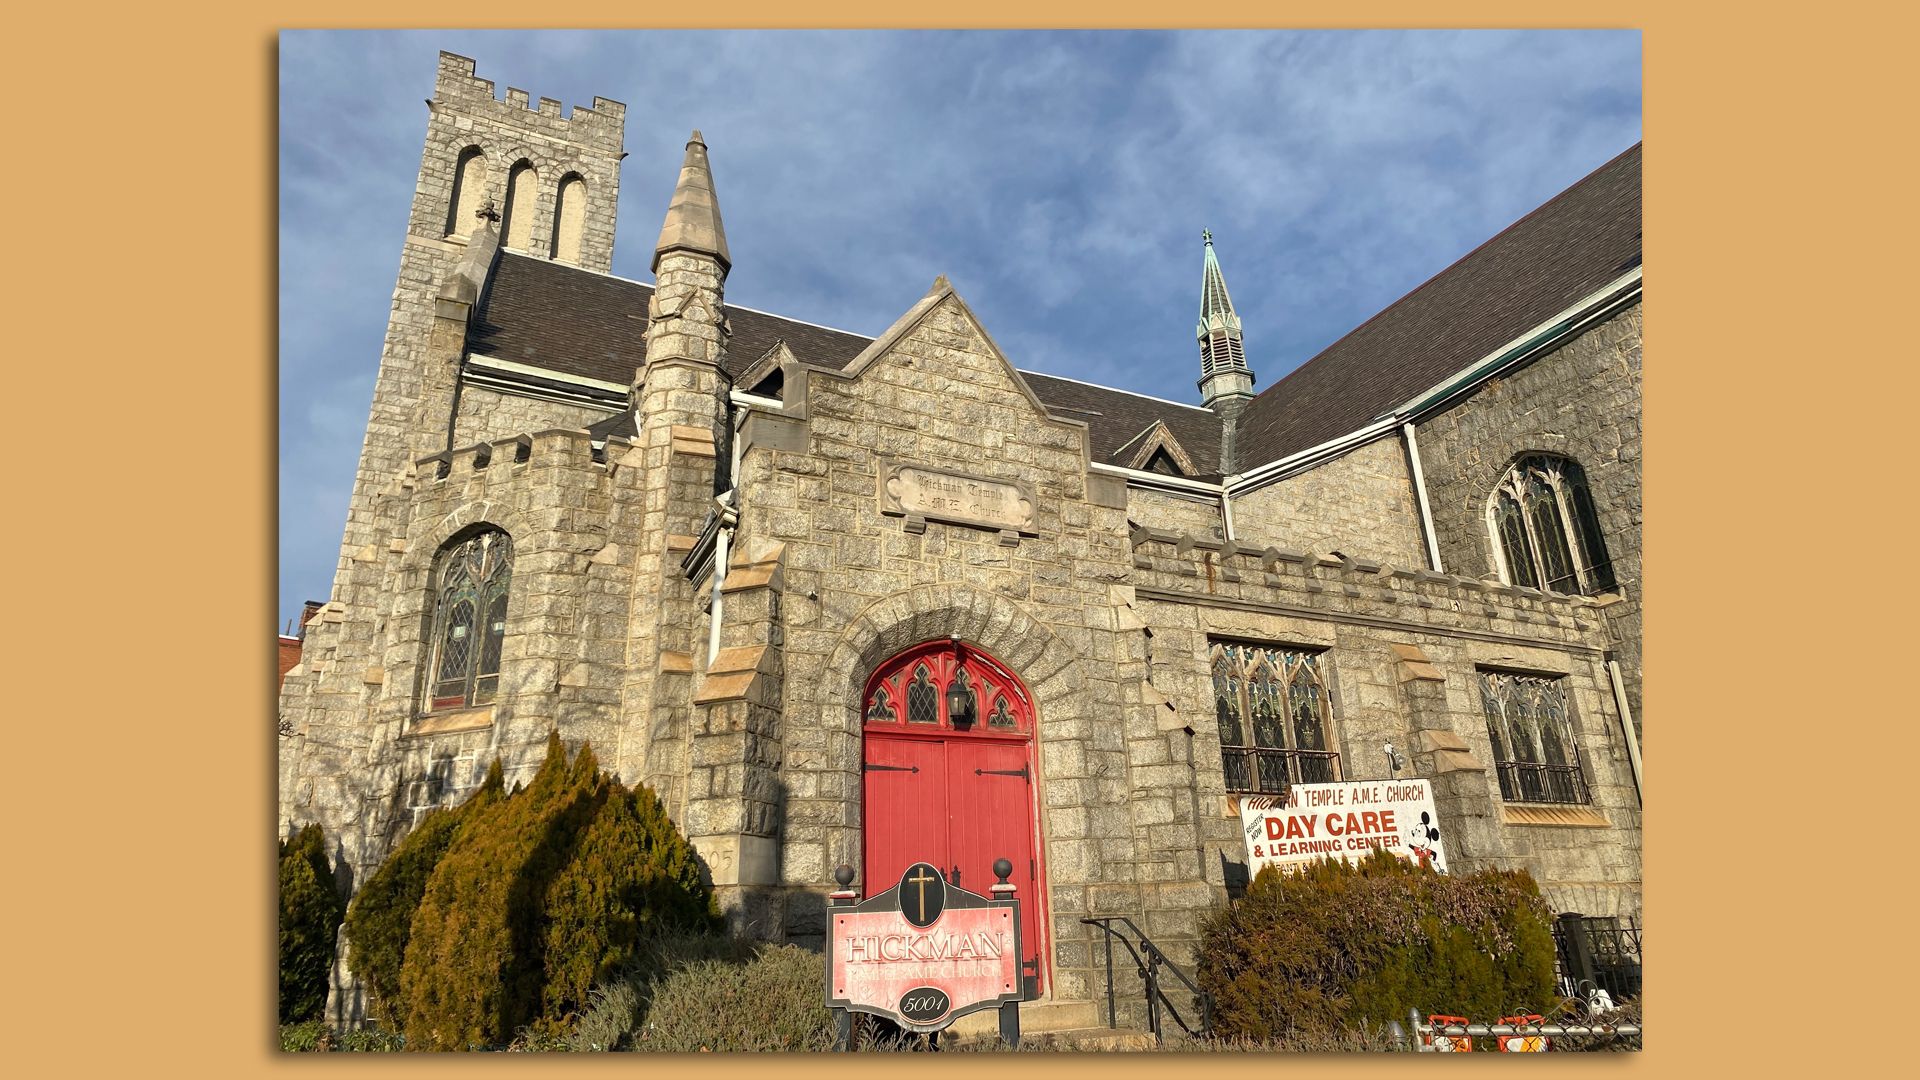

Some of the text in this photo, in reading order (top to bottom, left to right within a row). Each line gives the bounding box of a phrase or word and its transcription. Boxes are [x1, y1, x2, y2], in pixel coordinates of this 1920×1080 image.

[917, 475, 1003, 500] Hickman Temple
[1305, 789, 1344, 807] TEMPLE
[1351, 786, 1381, 805] A.M.E.
[1386, 784, 1424, 803] CHURCH
[1246, 812, 1264, 835] REGISTER
[1251, 825, 1264, 842] NOW
[1265, 810, 1398, 840] DAY CARE
[1254, 836, 1400, 858] & LEARNING CENTER
[847, 933, 1003, 962] HICKMAN
[941, 964, 1002, 979] CHURCH
[903, 996, 944, 1013] 5001
